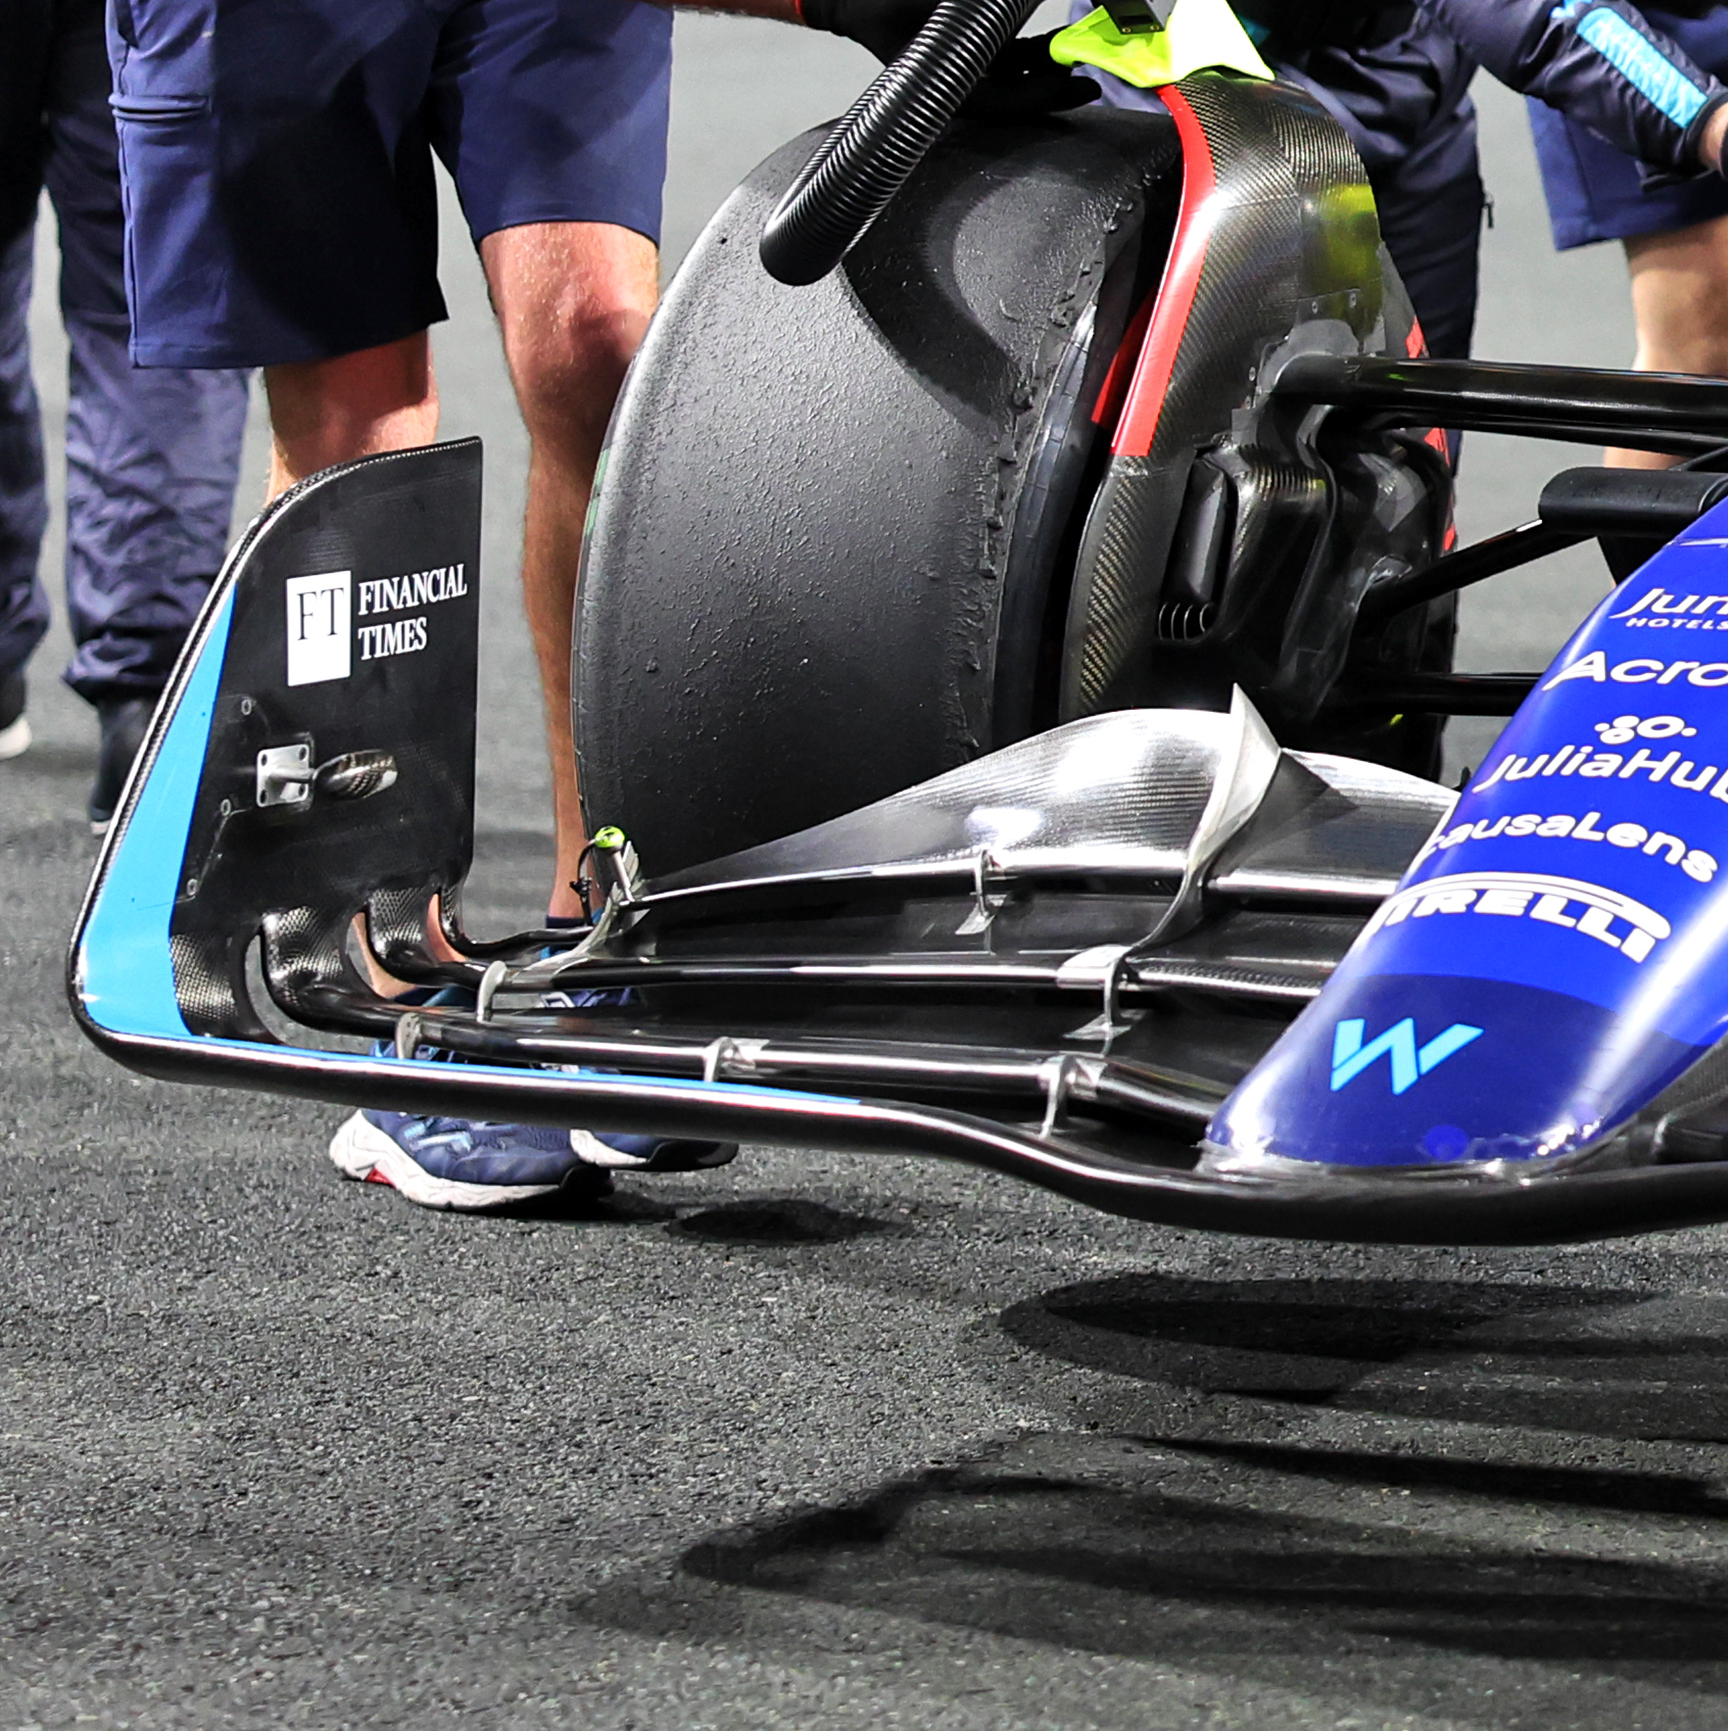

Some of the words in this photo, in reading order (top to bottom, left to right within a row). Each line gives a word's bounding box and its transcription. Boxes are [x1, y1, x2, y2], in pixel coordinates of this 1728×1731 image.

[297, 587, 345, 640] FT
[358, 564, 468, 616] FINANCIAL
[358, 617, 428, 661] TIMES
